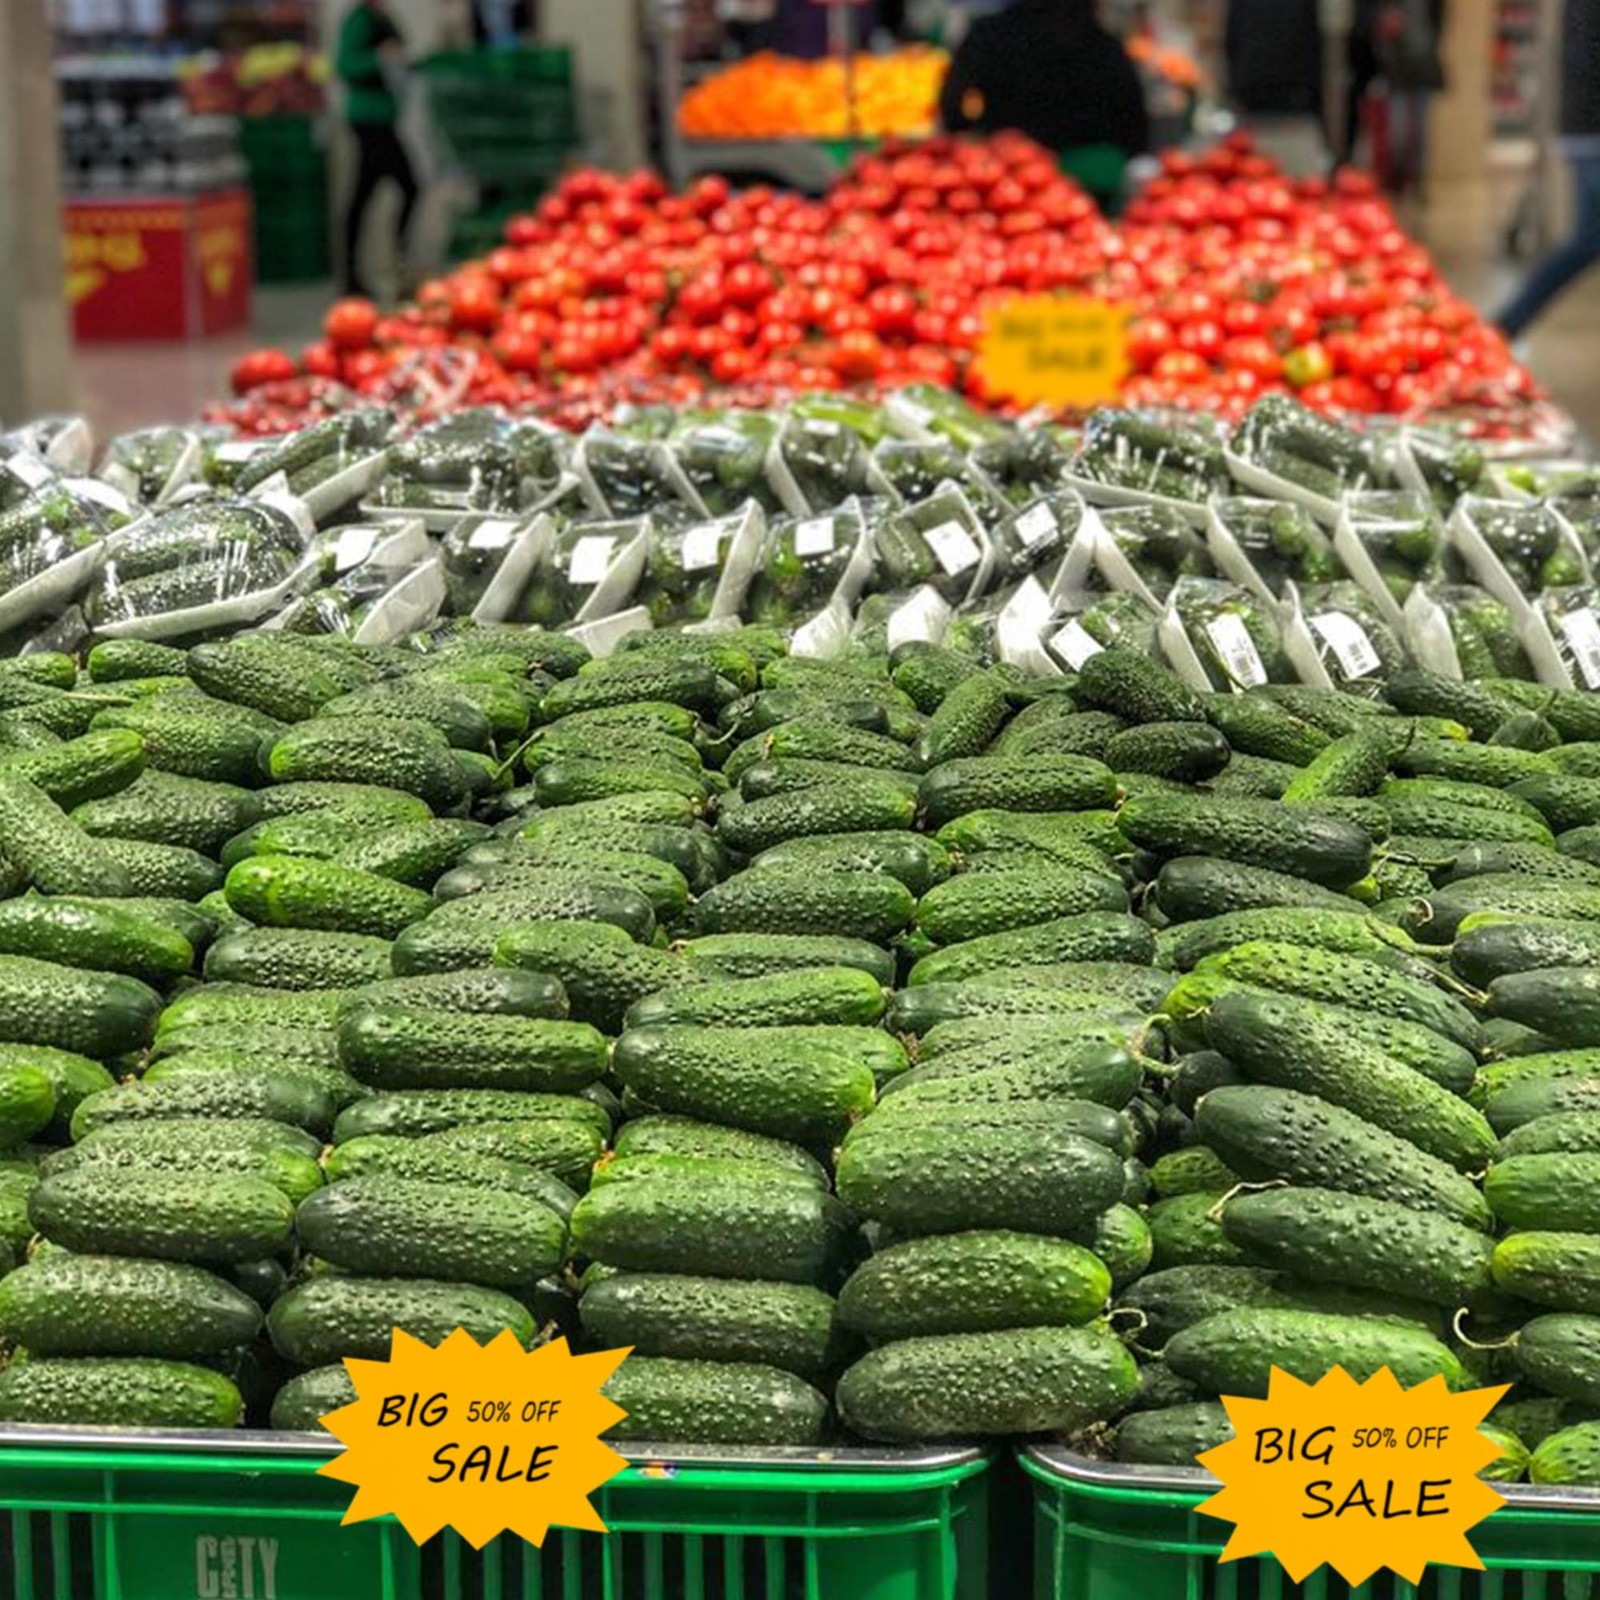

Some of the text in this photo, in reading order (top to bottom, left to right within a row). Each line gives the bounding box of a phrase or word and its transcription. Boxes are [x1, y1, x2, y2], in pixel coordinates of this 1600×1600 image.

[376, 1391, 563, 1428] BIG 50% OFF
[427, 1442, 560, 1484] SALE
[1253, 1425, 1450, 1466] BIG 50% OFF
[1300, 1478, 1453, 1520] SALE
